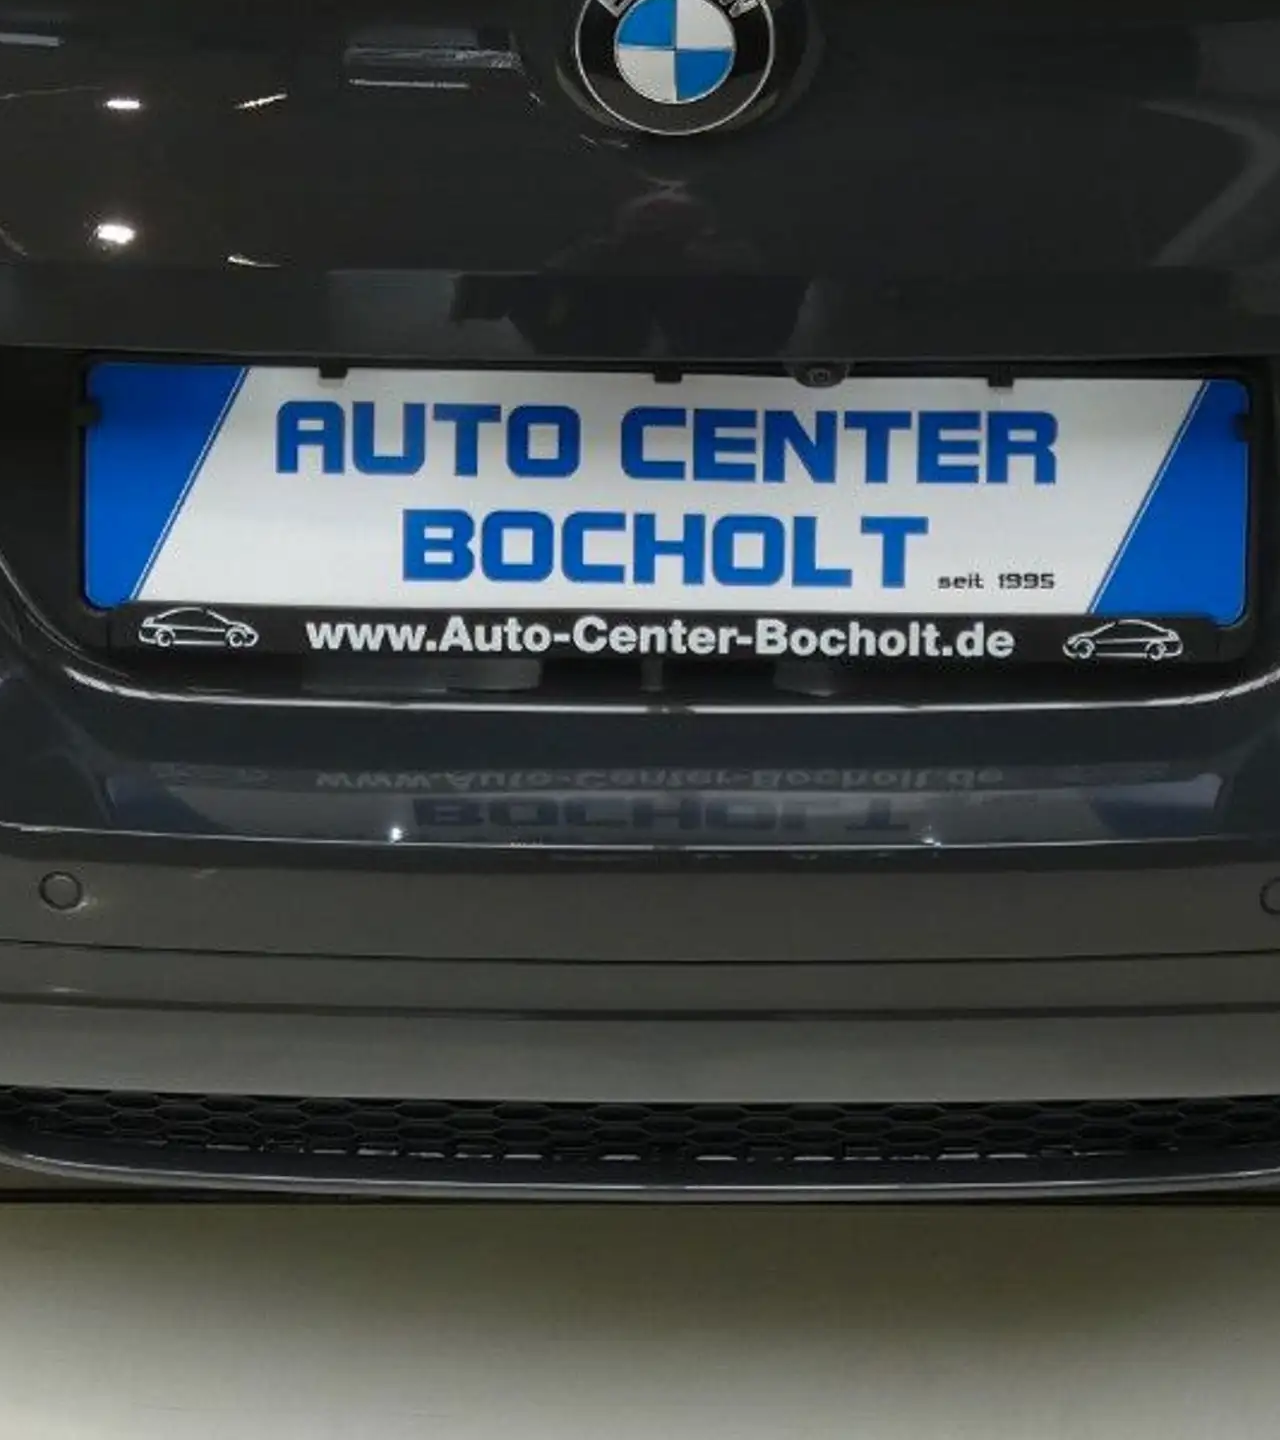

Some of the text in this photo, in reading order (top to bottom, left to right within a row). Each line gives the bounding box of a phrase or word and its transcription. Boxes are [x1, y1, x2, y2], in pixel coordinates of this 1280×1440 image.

[276, 400, 1059, 487] AUTO CENTER
[401, 507, 1056, 591] BOCHOLT seit 1995
[305, 615, 1017, 659] www.Auto-Center-Bocholt.de
